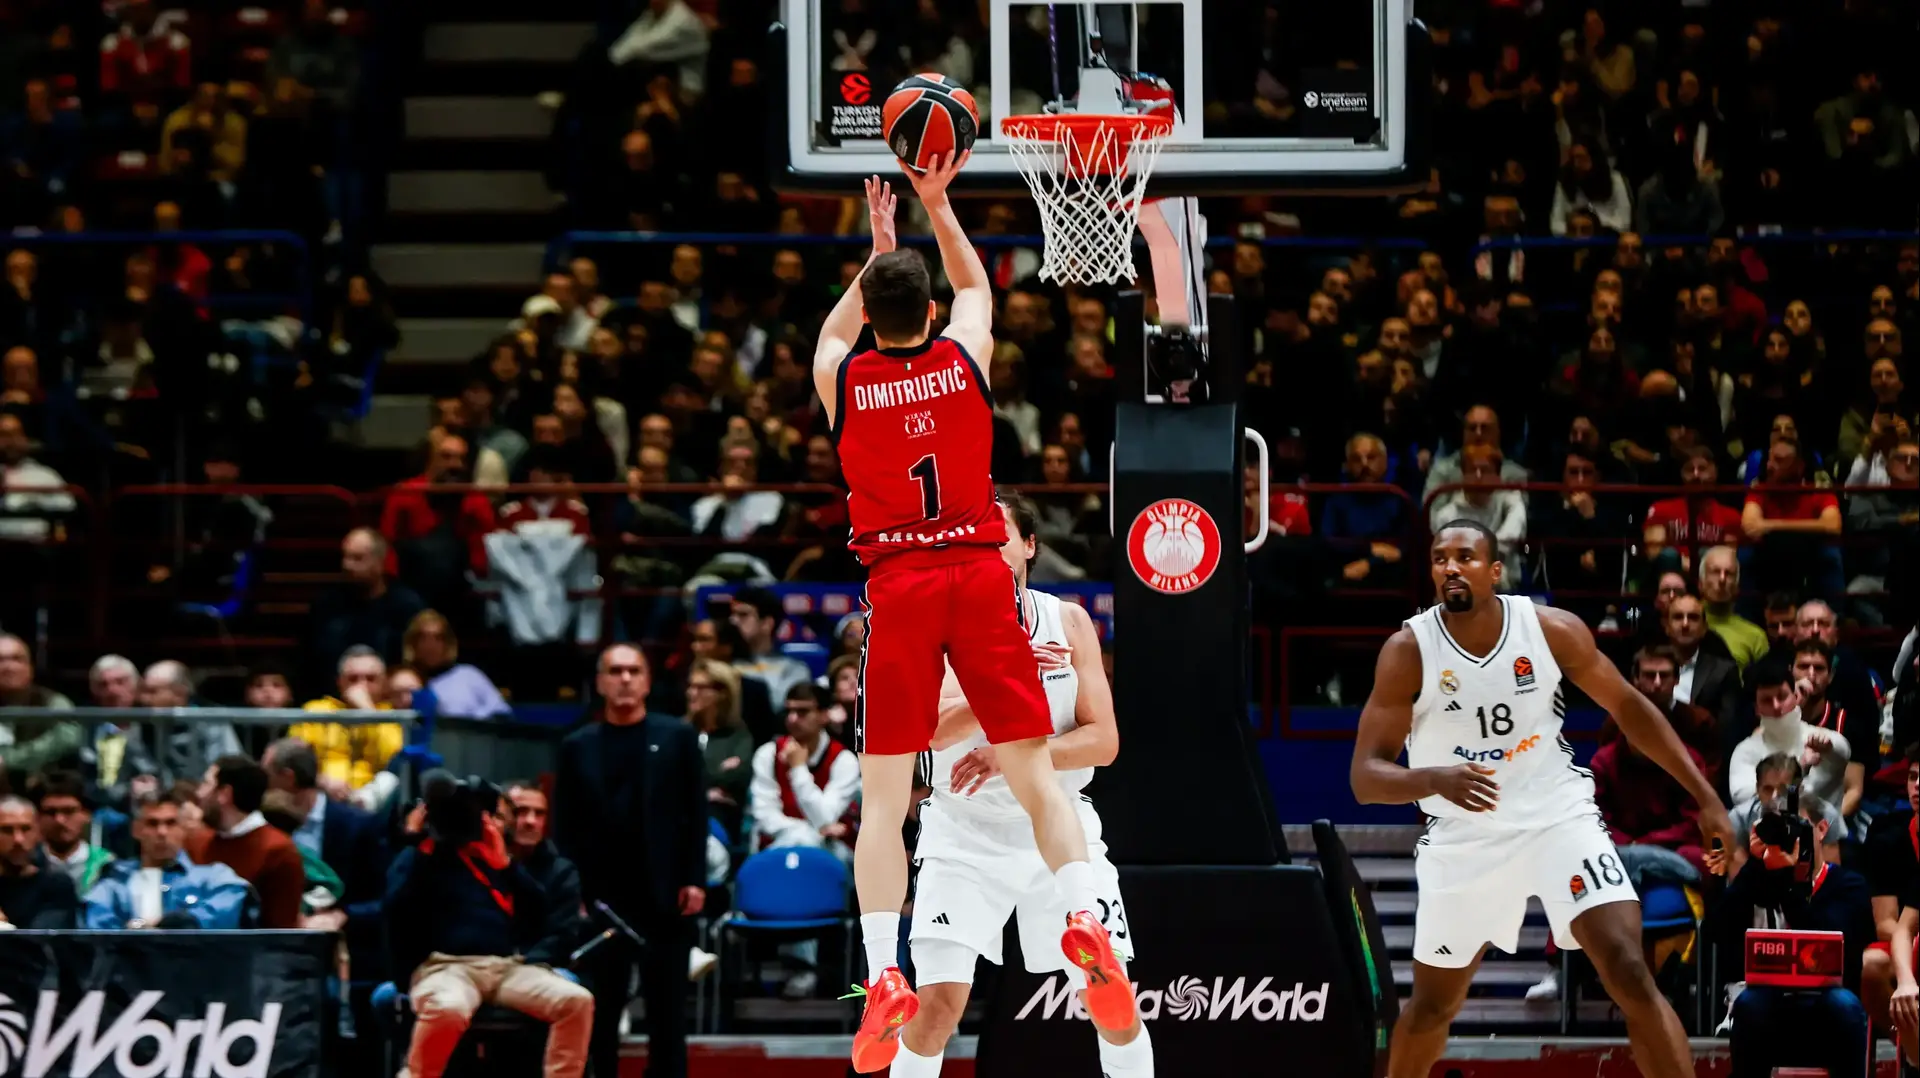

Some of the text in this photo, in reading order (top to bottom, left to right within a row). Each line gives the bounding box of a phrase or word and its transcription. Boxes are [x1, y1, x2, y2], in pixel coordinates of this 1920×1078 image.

[1321, 96, 1367, 111] oneteam
[854, 360, 967, 411] DIMITRIJEVIĆ
[908, 453, 941, 520] 1
[1146, 503, 1201, 524] OLIMPIA
[1150, 572, 1199, 591] MILANO
[1475, 702, 1514, 739] 18
[1582, 853, 1624, 890] 18
[1096, 897, 1127, 939] 23
[1753, 942, 1785, 956] FIBA
[1208, 976, 1330, 1021] World
[22, 990, 283, 1078] World
